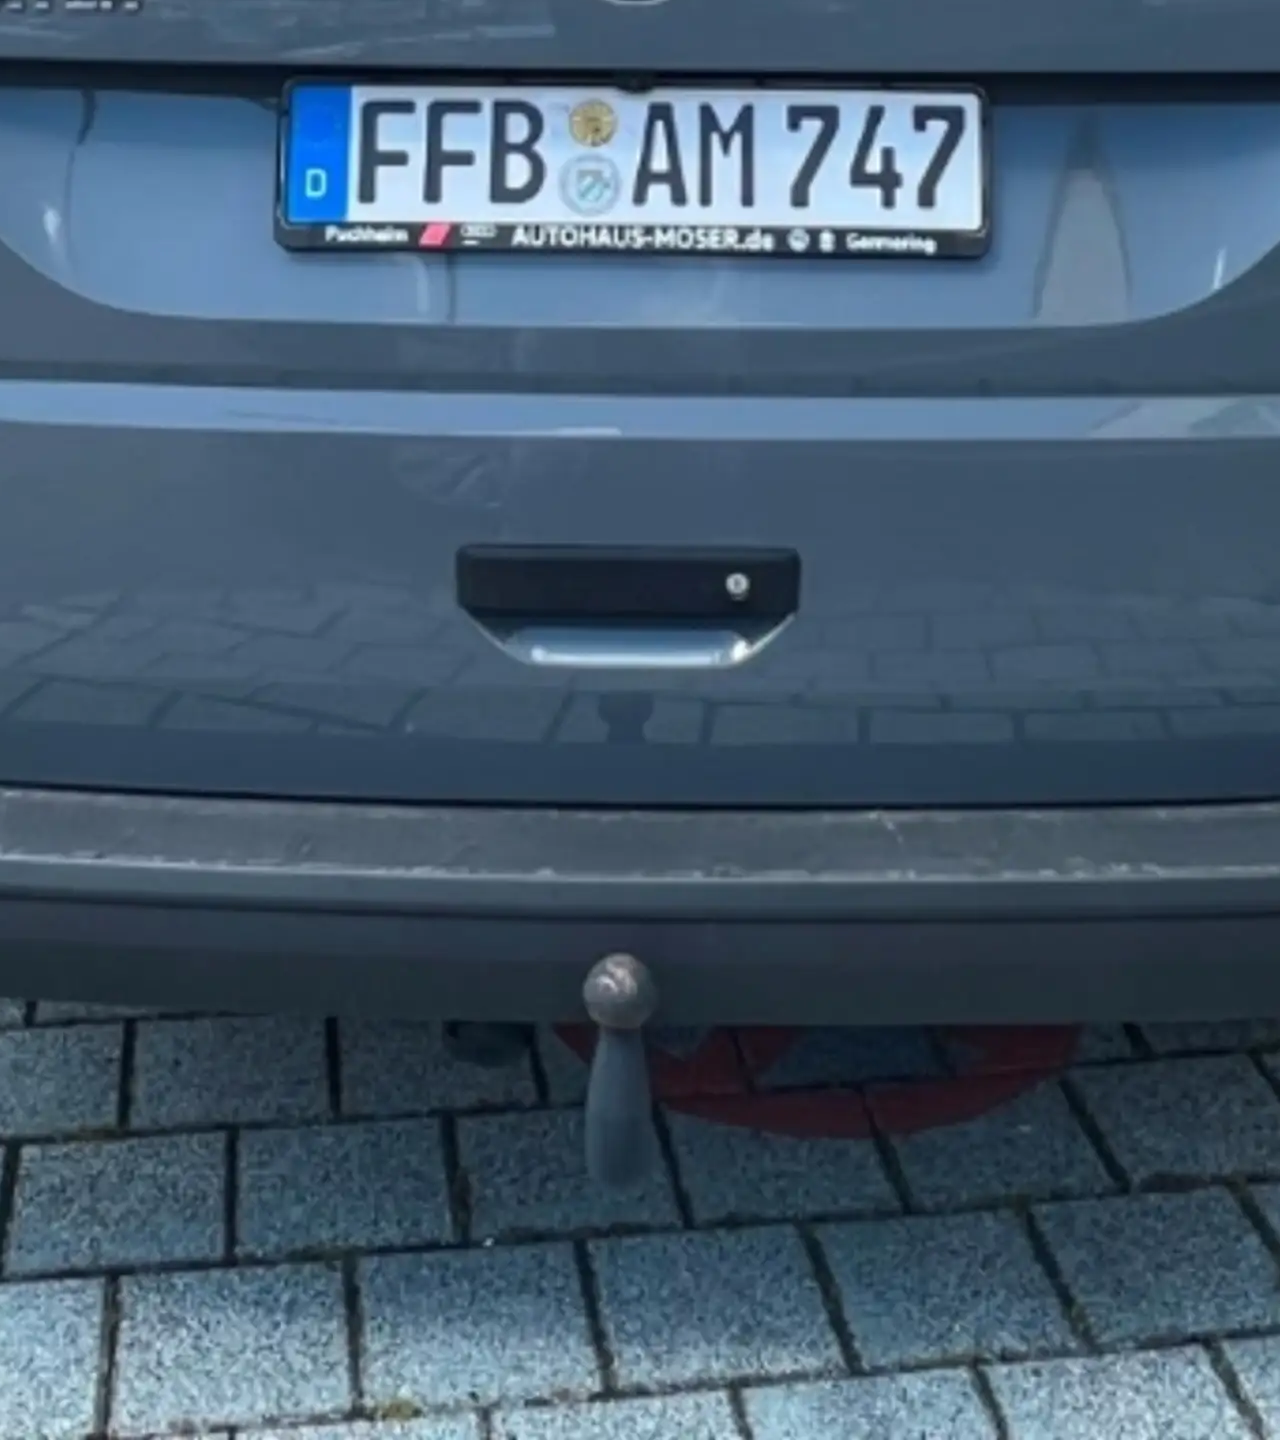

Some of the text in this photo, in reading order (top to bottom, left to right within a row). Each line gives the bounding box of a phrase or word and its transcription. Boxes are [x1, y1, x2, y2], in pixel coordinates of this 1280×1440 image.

[357, 98, 968, 209] FFB AM 747
[511, 224, 775, 252] AUTOHAUS-MOSER.de
